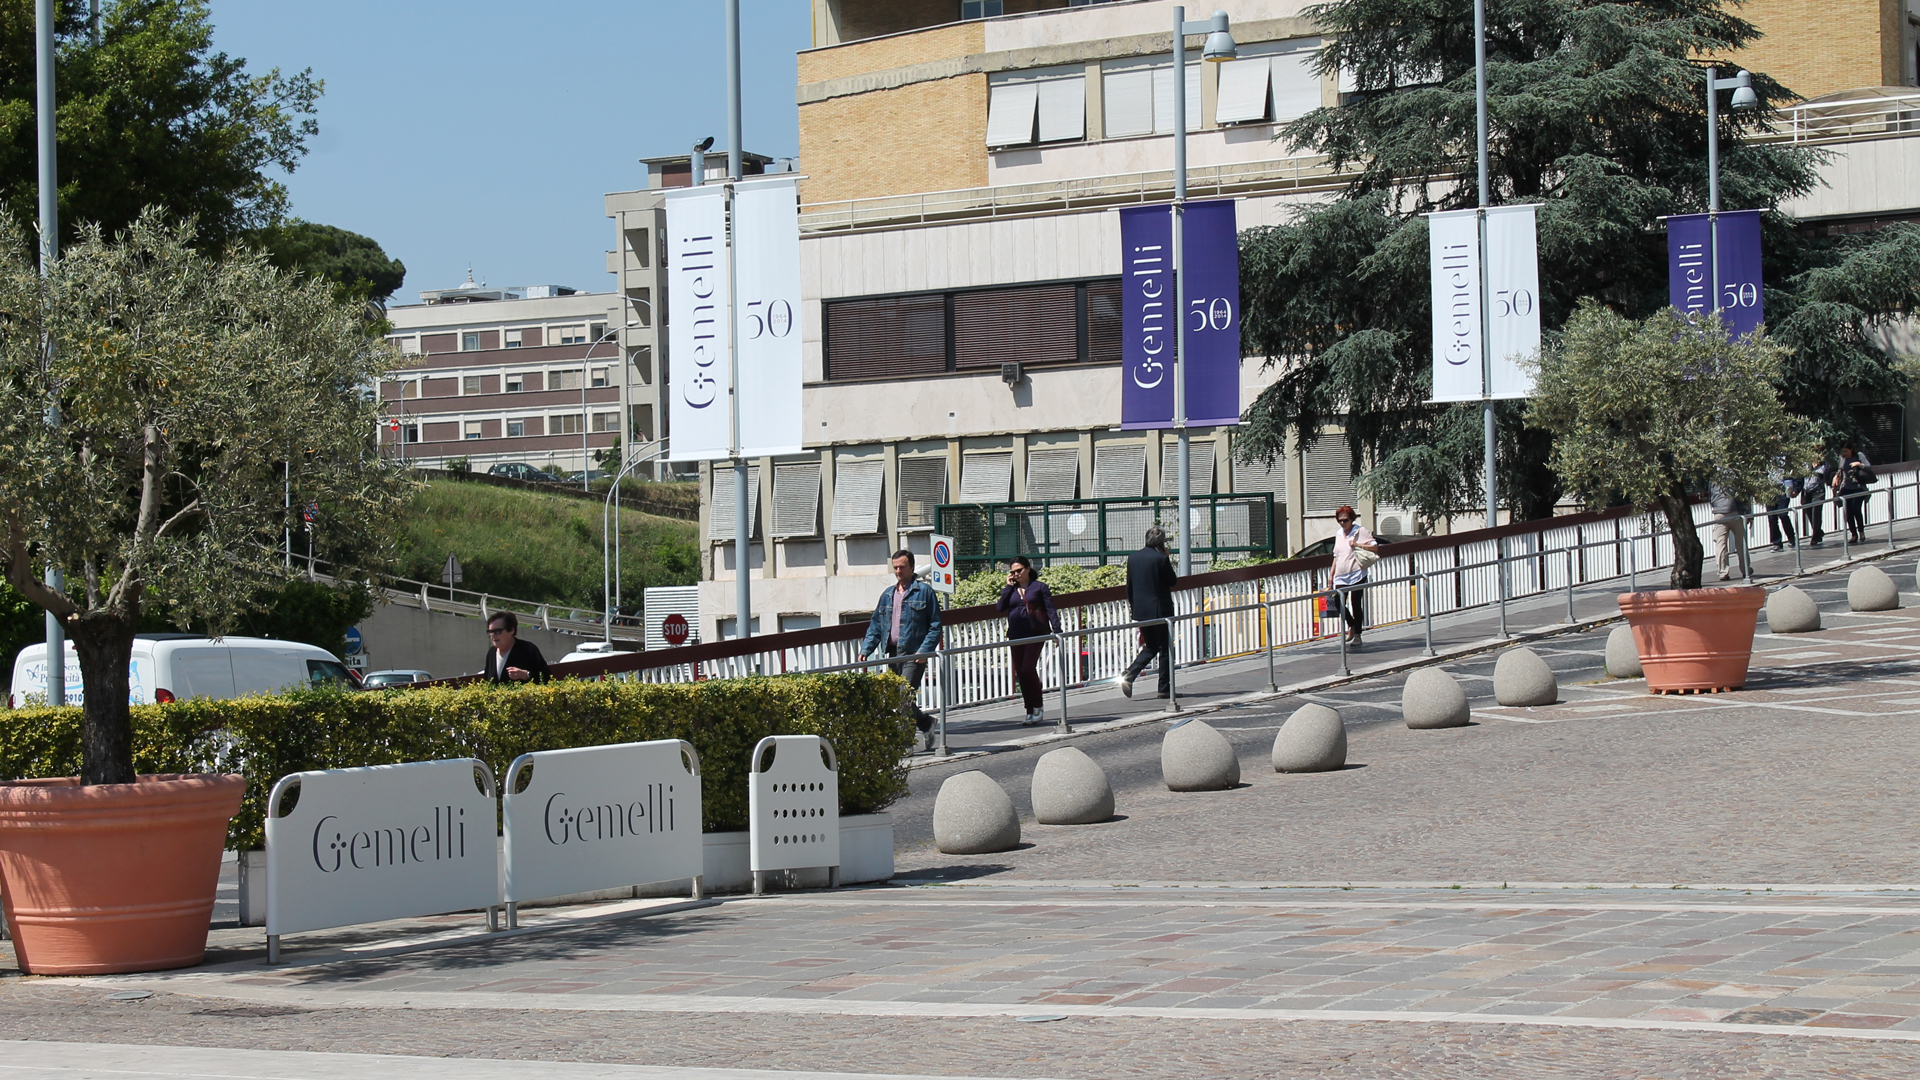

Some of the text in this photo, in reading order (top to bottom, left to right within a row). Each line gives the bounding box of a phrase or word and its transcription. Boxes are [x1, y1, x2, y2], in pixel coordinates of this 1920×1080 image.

[1190, 297, 1232, 332] 50
[1443, 244, 1471, 366] Gemelli
[1495, 289, 1532, 318] 50
[1678, 243, 1704, 325] emelli
[1723, 282, 1758, 309] 50
[682, 235, 717, 409] Gemelli
[745, 298, 793, 340] 50
[1133, 245, 1164, 389] Gemelli
[664, 623, 687, 635] STOP
[312, 805, 465, 873] Gemelli
[544, 783, 675, 845] Gemelli
